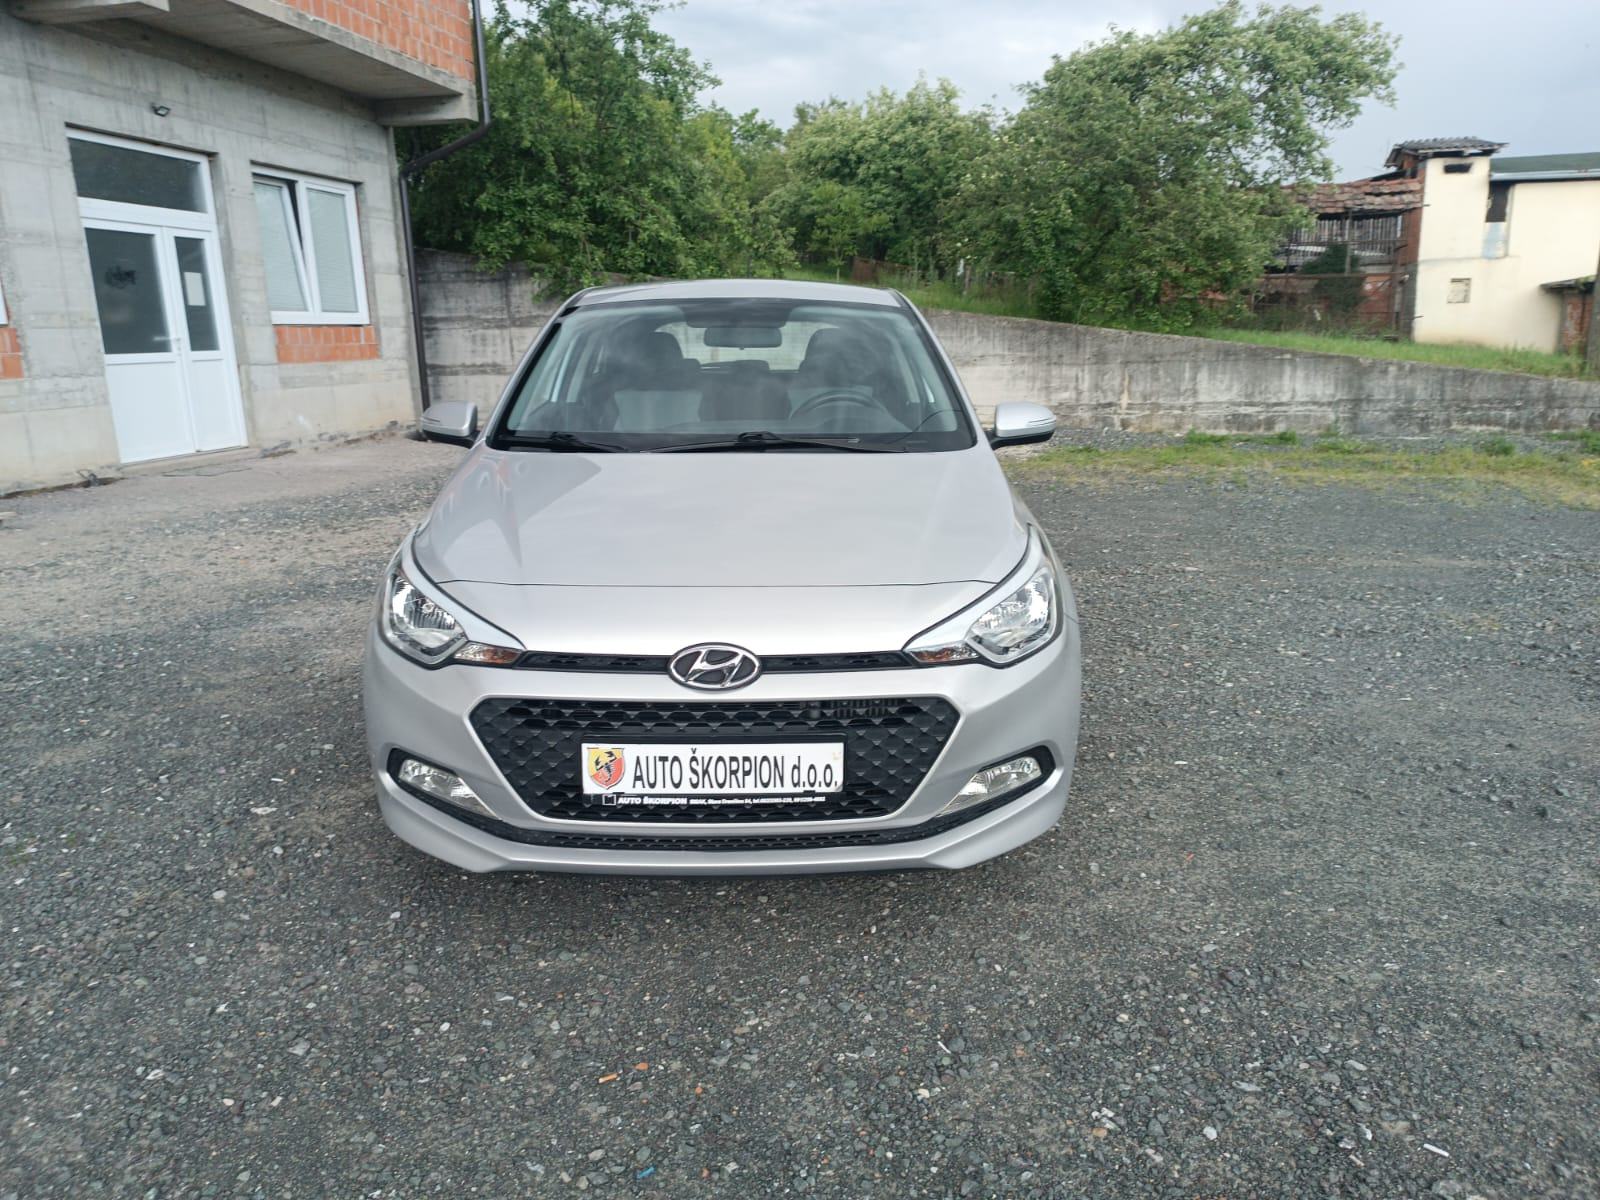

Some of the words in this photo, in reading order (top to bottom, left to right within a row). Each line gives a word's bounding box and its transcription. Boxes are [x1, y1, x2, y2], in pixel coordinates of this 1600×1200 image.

[632, 755, 683, 790] AUTO
[689, 747, 785, 790] ŠKORPION
[790, 755, 838, 789] d.o.o.
[617, 797, 642, 805] AUTO
[643, 795, 688, 805] ŠKORPION
